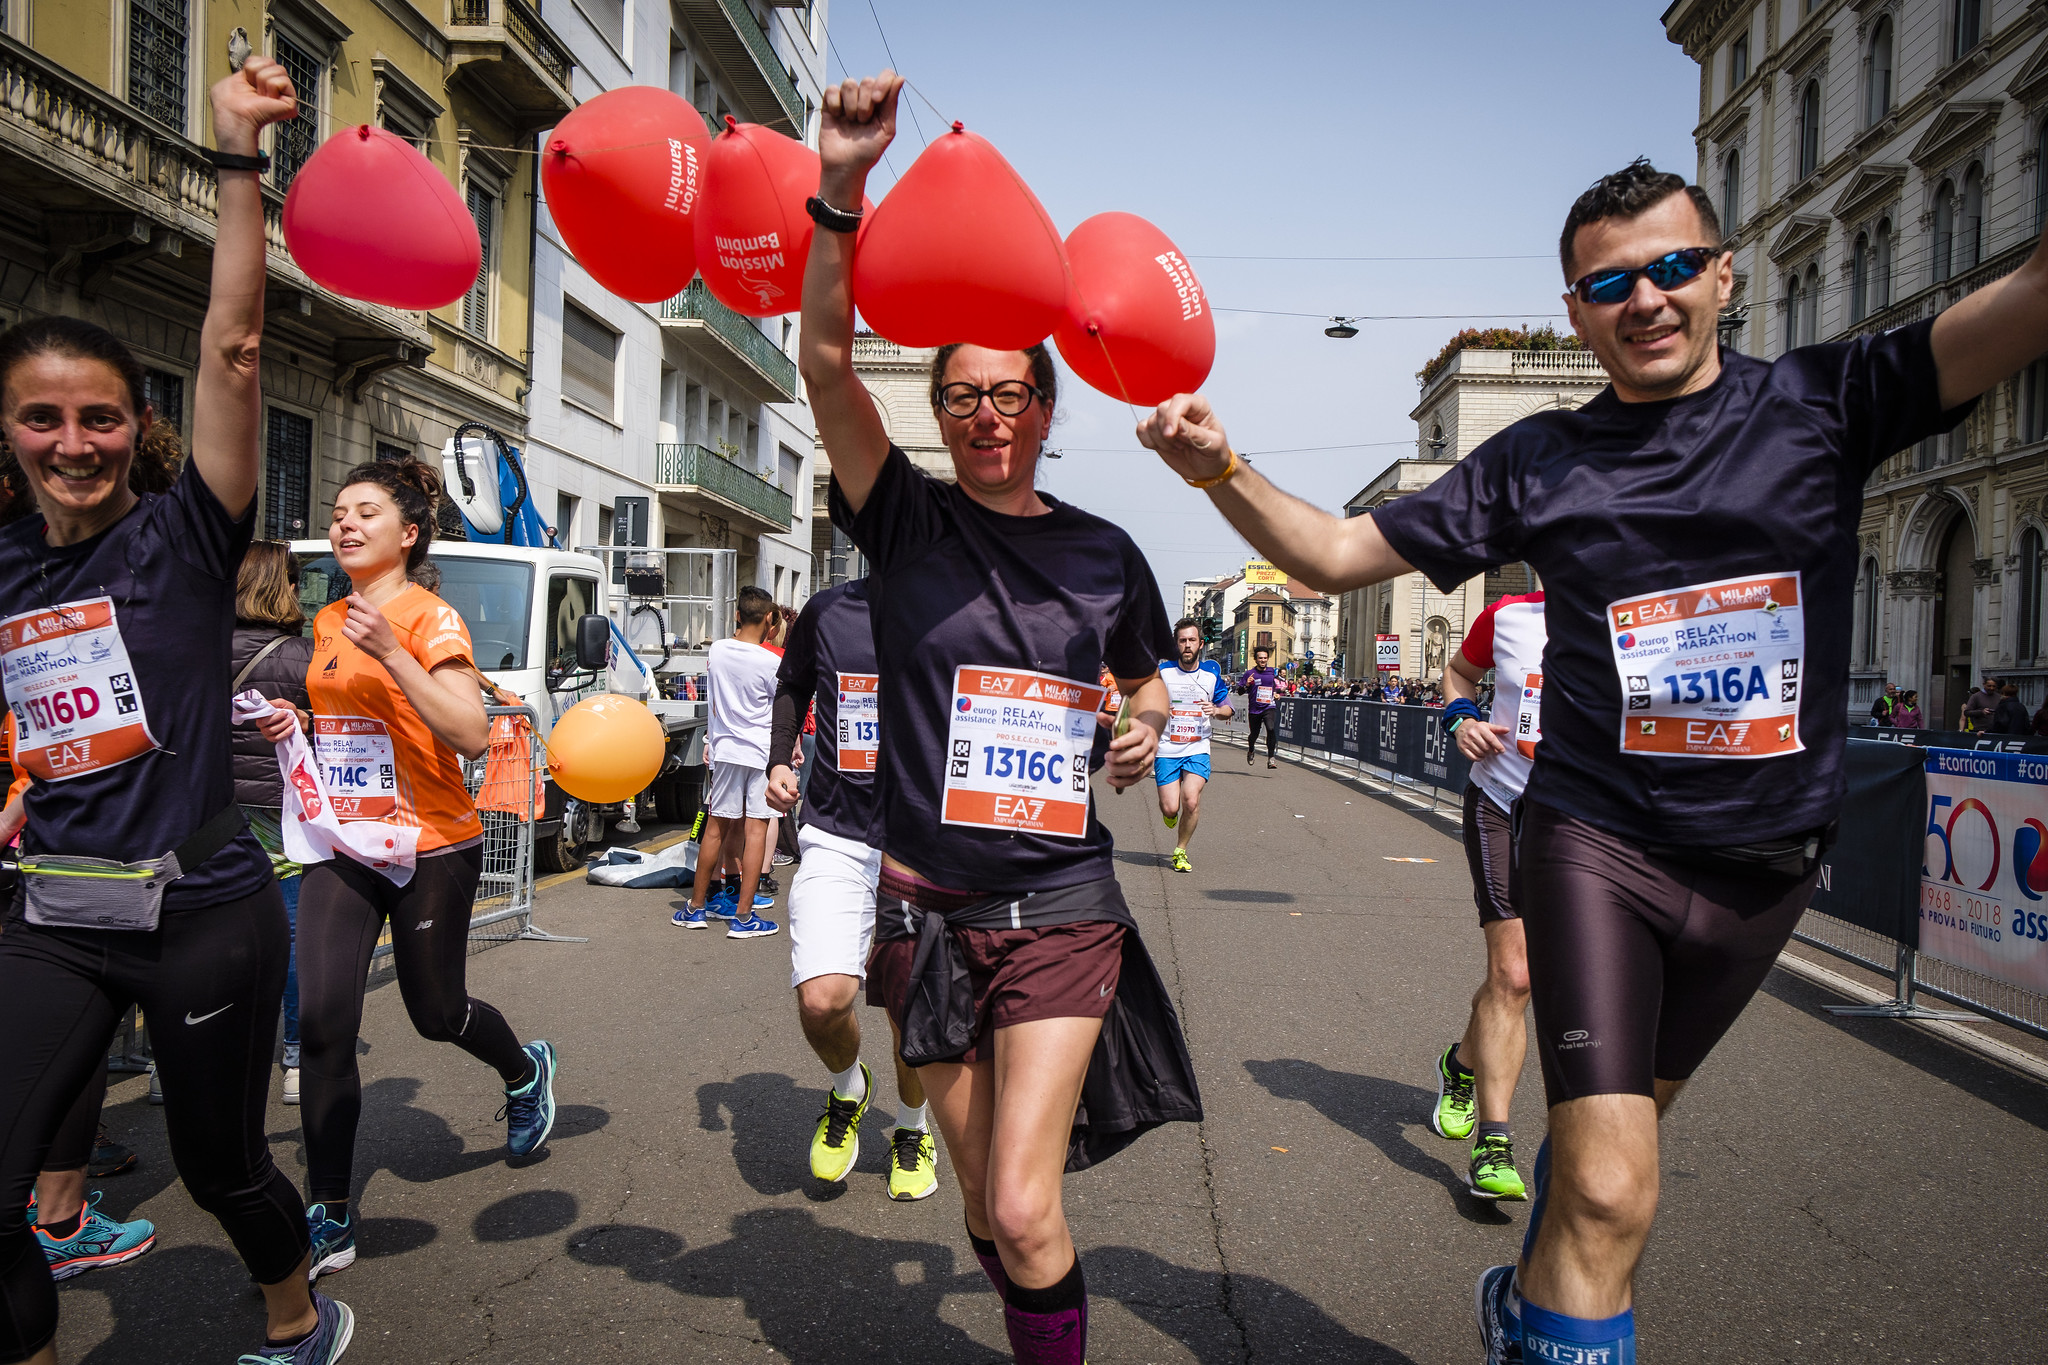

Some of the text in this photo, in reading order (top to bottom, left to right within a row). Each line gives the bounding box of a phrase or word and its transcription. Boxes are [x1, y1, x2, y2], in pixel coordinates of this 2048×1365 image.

[664, 137, 684, 211] Bambini
[680, 143, 700, 215] Mission
[715, 232, 780, 255] Bambini
[720, 252, 785, 275] Mission
[1154, 254, 1195, 321] Bambini
[1166, 251, 1202, 316] Mission
[1720, 585, 1771, 600] MILANO
[1722, 594, 1772, 607] MARATHON
[1638, 598, 1679, 621] EA7
[1639, 635, 1669, 648] europ
[1675, 622, 1728, 641] RELAY
[1677, 631, 1757, 651] MARATHON
[16, 651, 48, 668] RELAY
[1378, 645, 1399, 655] 200
[1620, 645, 1671, 660] assistance
[1675, 651, 1755, 667] PRO S.E.C.C.O. TEAM
[20, 655, 78, 677] MARATHON
[57, 674, 78, 684] TEAM
[848, 679, 866, 688] EA7
[980, 675, 1015, 692] EA7
[1663, 665, 1770, 705] 1316A
[1044, 692, 1080, 704] MARATHON
[1045, 683, 1082, 698] MILANO
[25, 687, 100, 731] 1316D
[955, 714, 997, 725] assistance
[973, 706, 997, 716] europ
[1003, 706, 1044, 719] RELAY
[1279, 701, 1295, 729] EA7
[1311, 704, 1326, 735] EA7
[320, 721, 336, 730] EA7
[855, 722, 880, 740] 131
[1002, 717, 1062, 733] MARATHON
[1177, 725, 1196, 733] 2197D
[1344, 706, 1360, 741] EA7
[1379, 710, 1398, 750] EA7
[1686, 721, 1751, 746] EA7
[996, 733, 1057, 747] PRO S.E.C.C.O. TEAM
[46, 738, 91, 769] EA7
[865, 752, 875, 764] E
[1938, 752, 1996, 776] #corricon
[983, 746, 1065, 784] 1316C
[2018, 759, 2048, 780] #cor
[329, 766, 368, 787] 714C
[333, 798, 361, 812] EA7
[994, 795, 1046, 820] EA7
[690, 811, 706, 838] arena
[1922, 794, 2000, 892] 50
[1920, 886, 1951, 911] 1968
[1966, 897, 2001, 926] 2018
[1928, 910, 1956, 929] PROVA
[1959, 919, 1968, 932] DI
[1970, 924, 2001, 942] FUTURO
[2012, 909, 2048, 942] ass
[1527, 1336, 1611, 1365] OXI-JET
